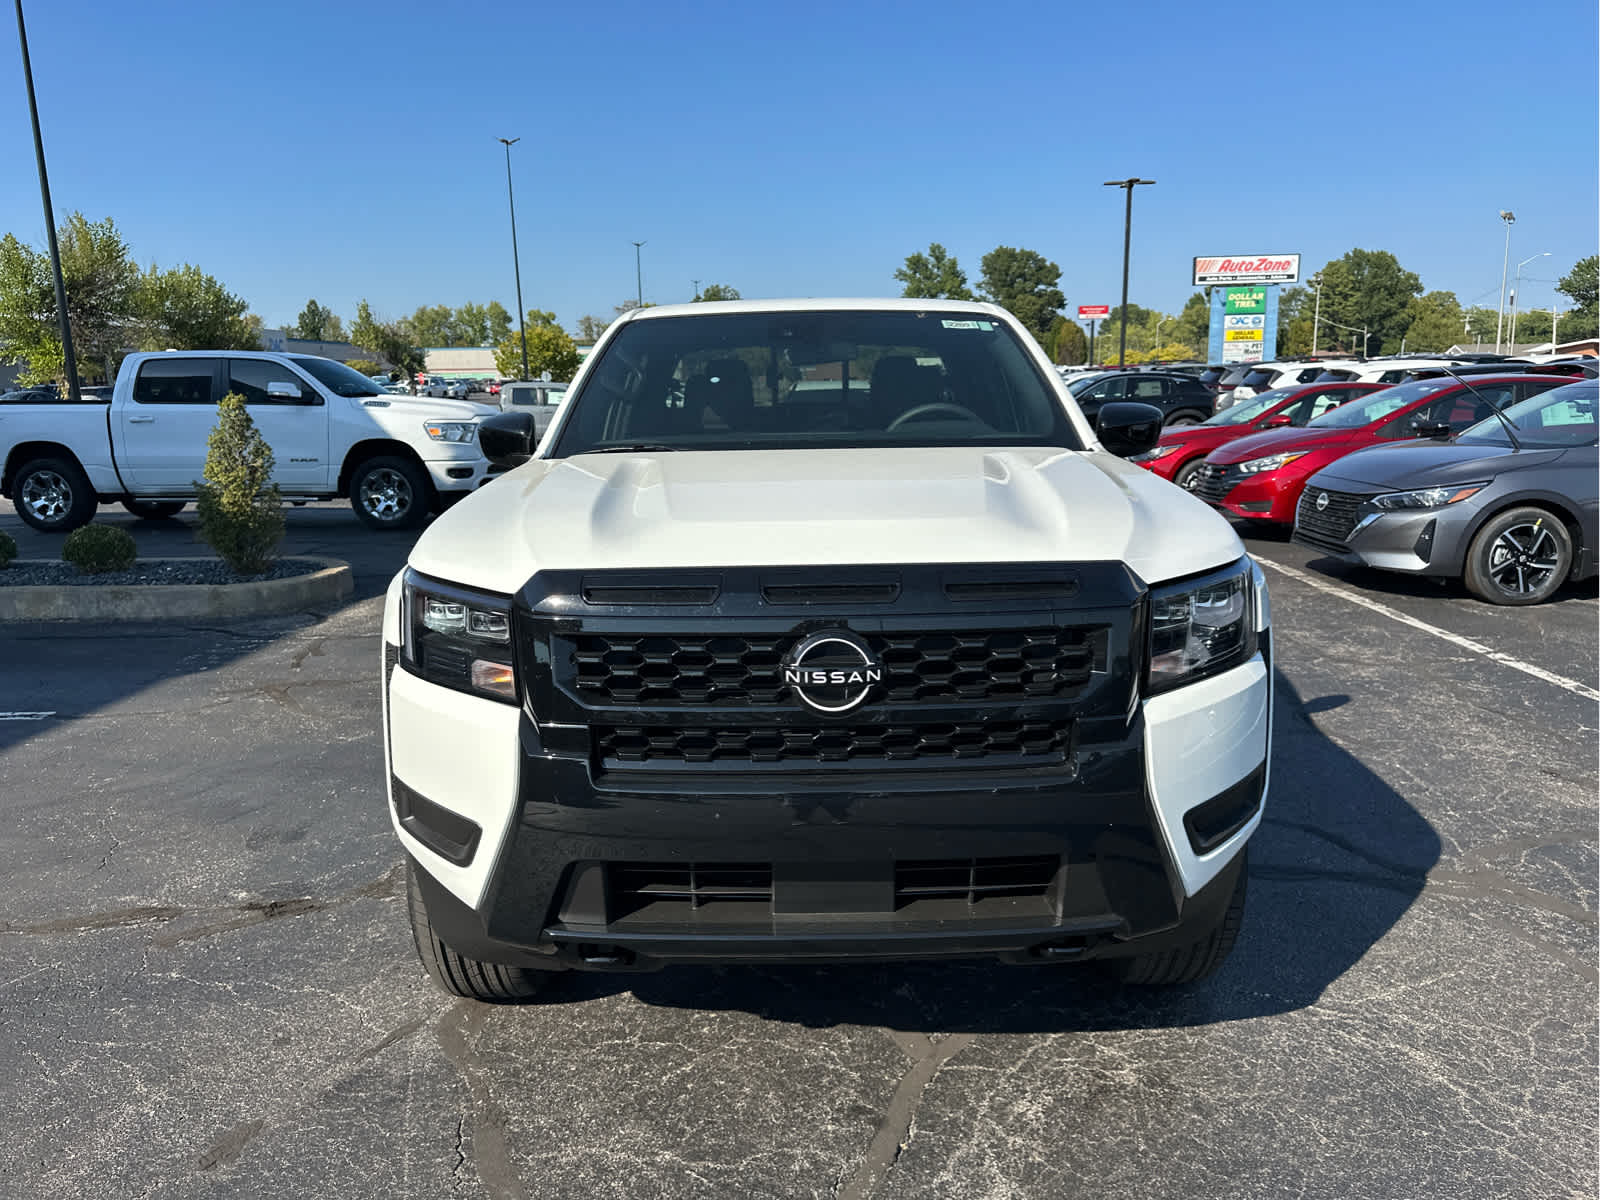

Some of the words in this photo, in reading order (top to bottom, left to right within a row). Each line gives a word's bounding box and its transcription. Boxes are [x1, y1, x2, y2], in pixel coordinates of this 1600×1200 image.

[1218, 258, 1291, 272] AutoZone
[1228, 292, 1264, 300] DOLLAR
[785, 669, 881, 684] NISSAN
